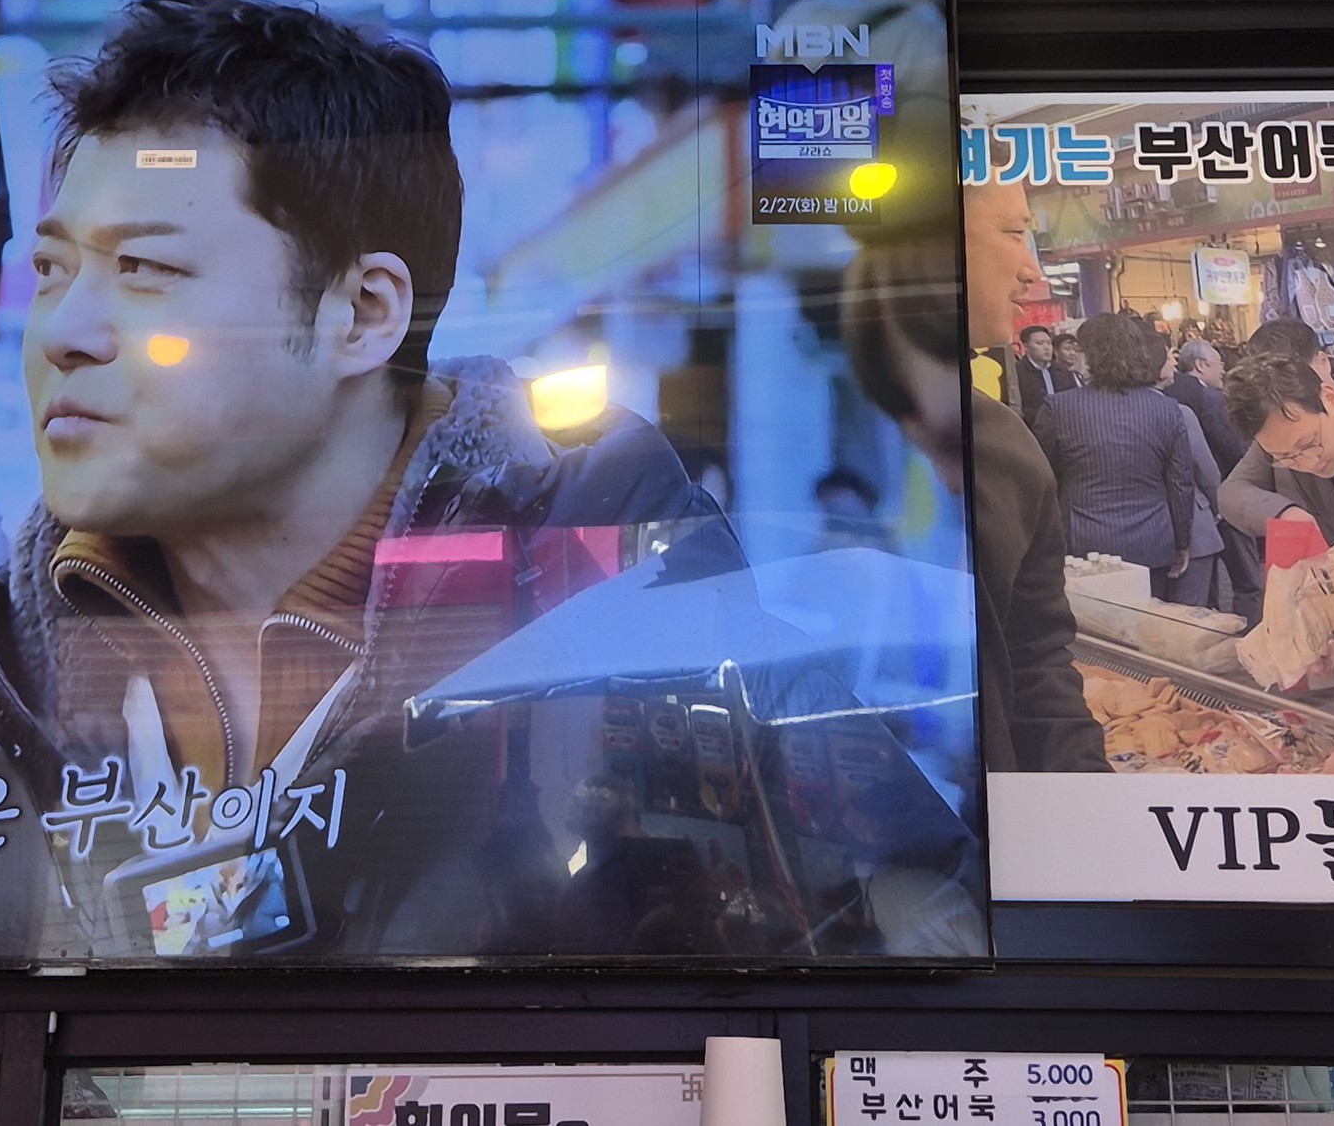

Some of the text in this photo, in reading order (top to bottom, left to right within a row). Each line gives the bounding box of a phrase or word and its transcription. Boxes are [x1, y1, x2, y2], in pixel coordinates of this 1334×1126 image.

[756, 24, 870, 58] MBN
[758, 100, 871, 140] 현역가왕
[759, 198, 820, 214] 2/27(화)
[824, 198, 838, 214] 밤
[42, 756, 347, 858] 부산이지
[1027, 1064, 1093, 1086] 5,000
